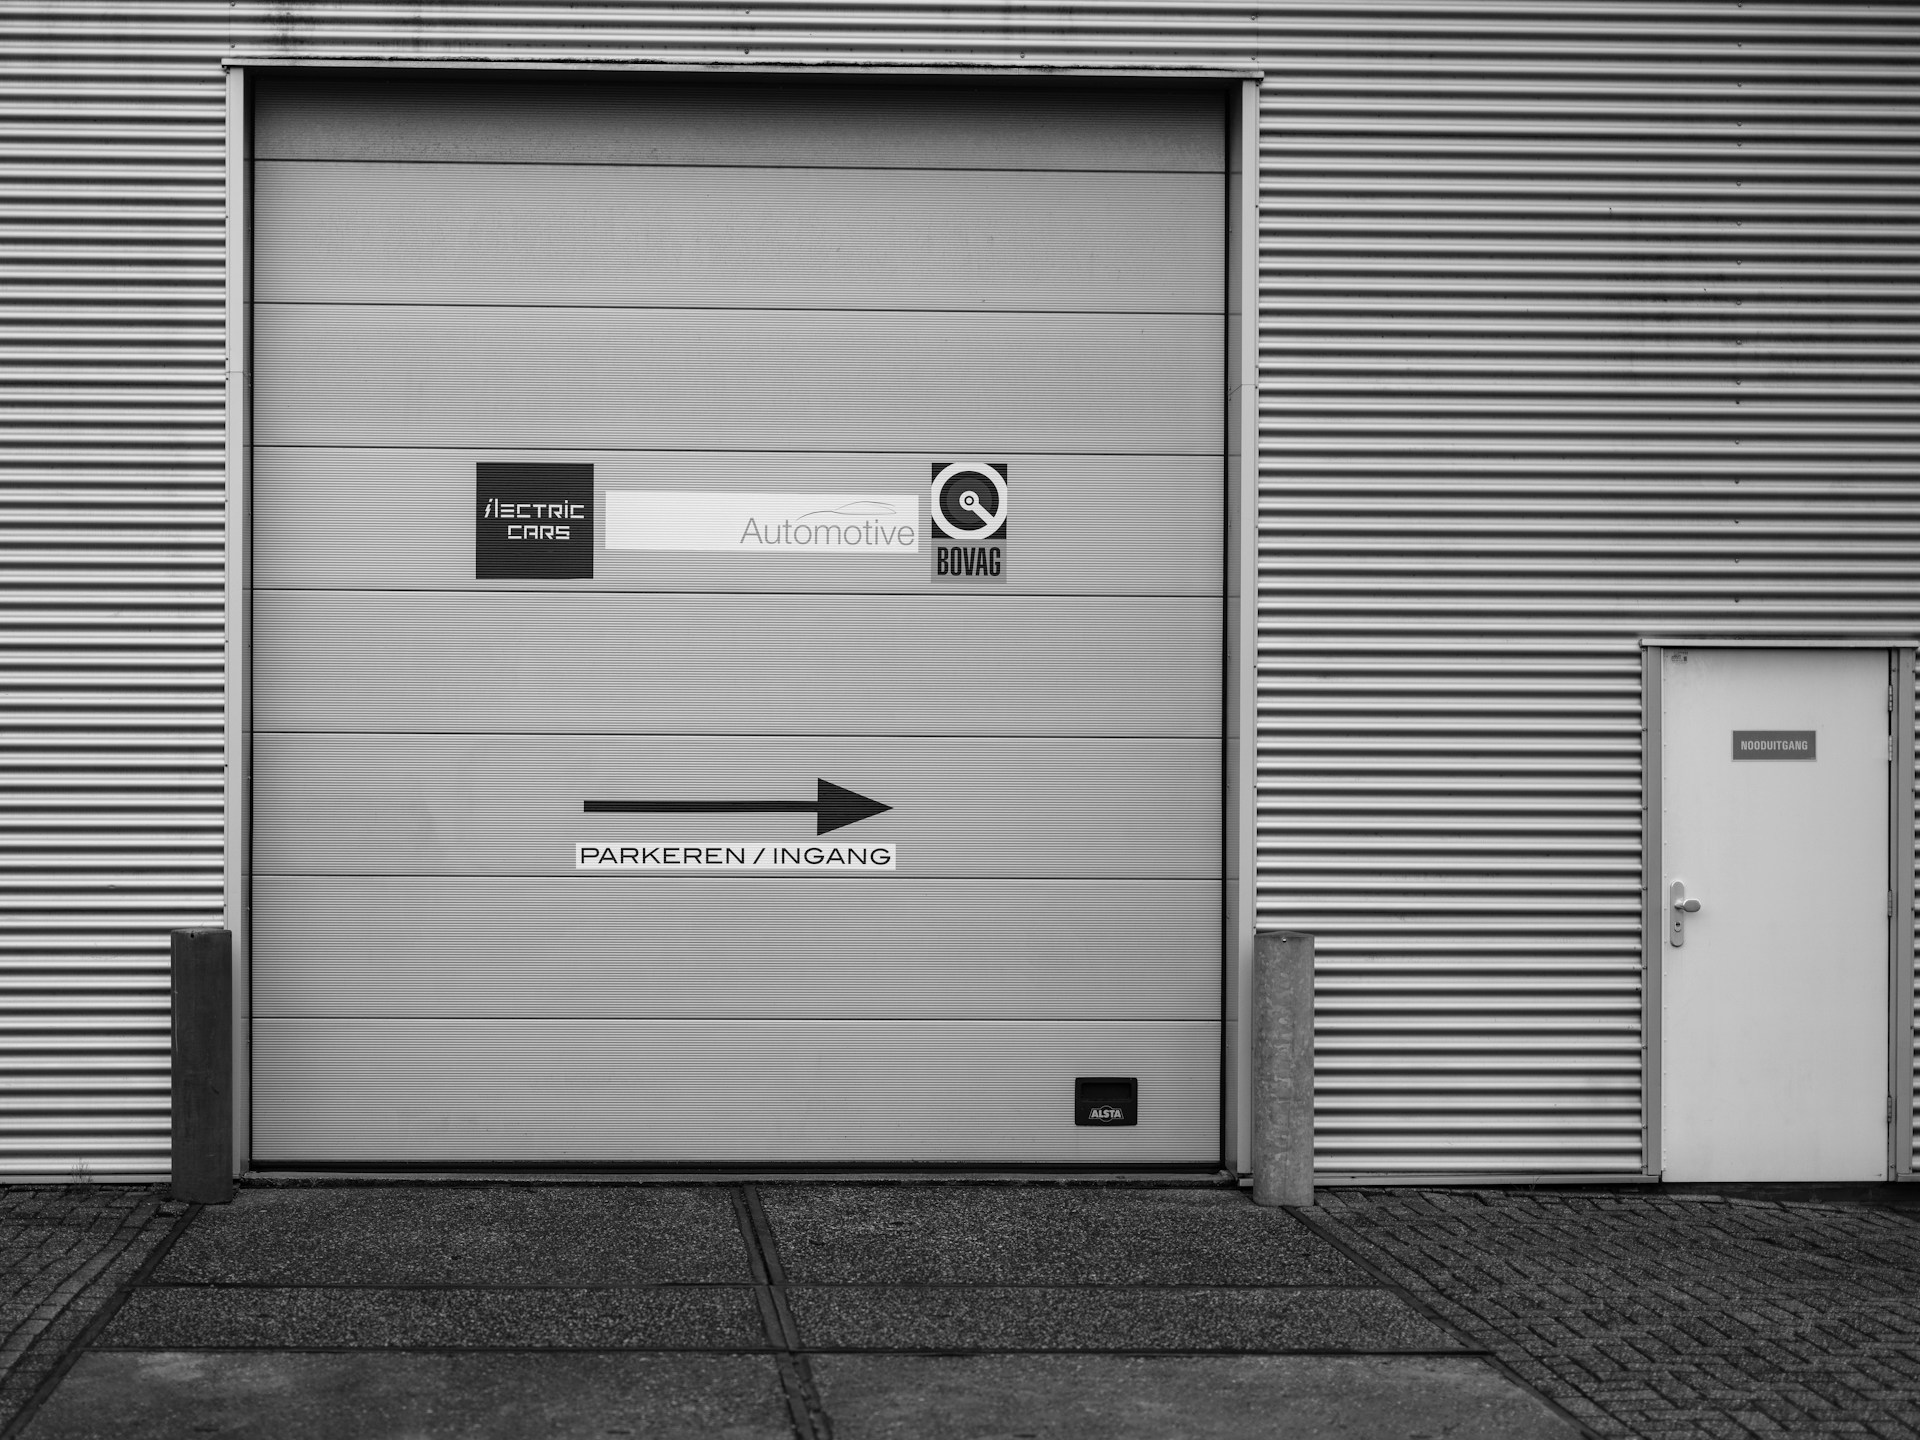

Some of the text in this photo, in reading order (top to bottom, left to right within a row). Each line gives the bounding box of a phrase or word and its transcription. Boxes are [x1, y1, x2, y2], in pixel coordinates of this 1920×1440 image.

[507, 525, 570, 540] CARS
[739, 517, 915, 546] Automotive
[937, 546, 1001, 577] BOVAG
[1740, 740, 1808, 751] NOODUITGANG
[581, 847, 745, 864] PARKEREN
[773, 848, 891, 865] INGANG
[1091, 1109, 1121, 1118] ALSTA
